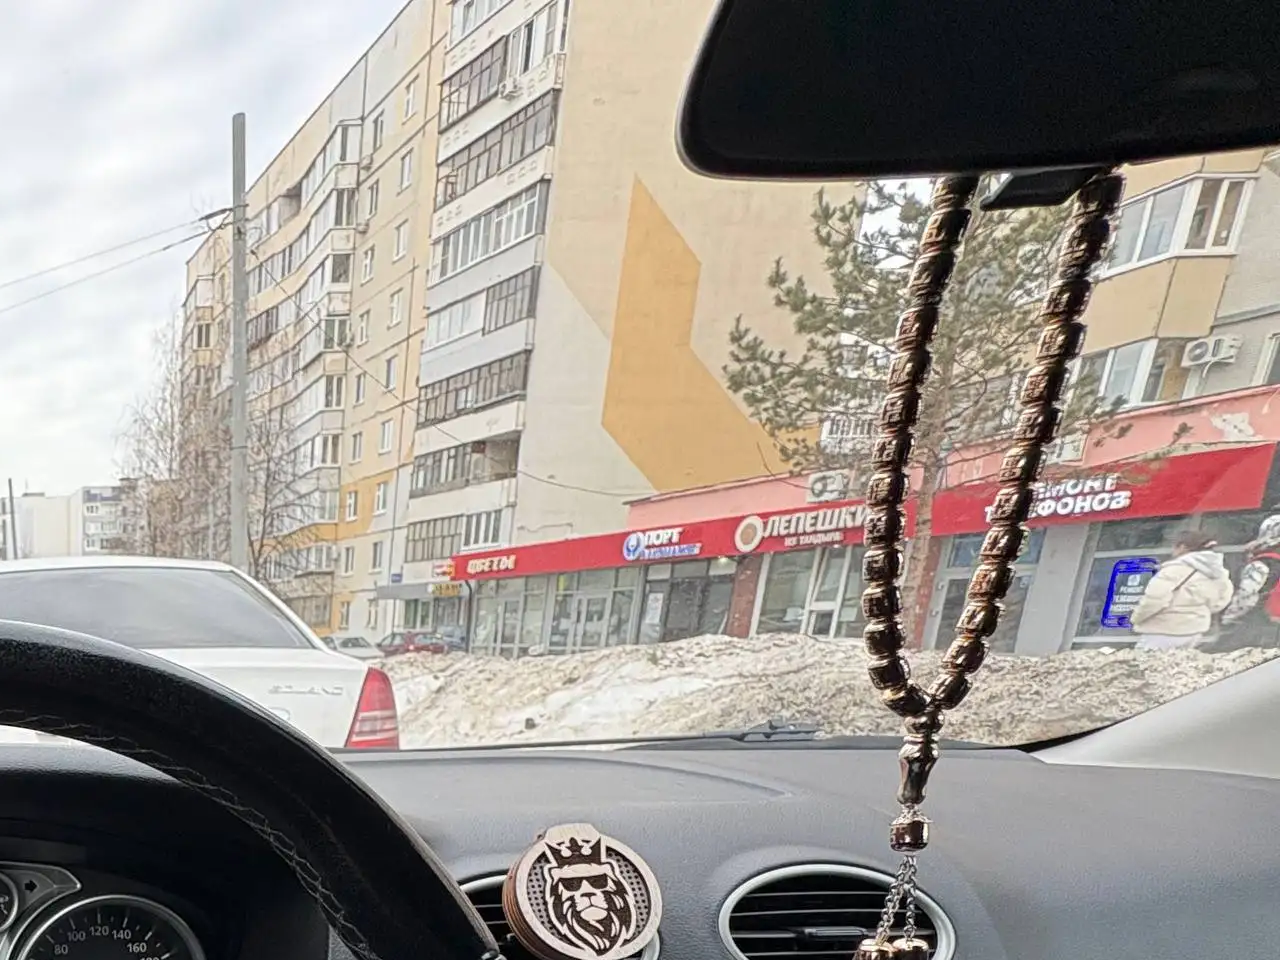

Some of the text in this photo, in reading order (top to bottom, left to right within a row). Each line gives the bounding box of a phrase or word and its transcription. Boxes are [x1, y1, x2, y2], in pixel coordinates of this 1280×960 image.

[67, 931, 86, 941] 100
[89, 926, 109, 936] 120
[111, 929, 132, 940] 140
[54, 944, 69, 954] 80
[126, 942, 147, 953] 160
